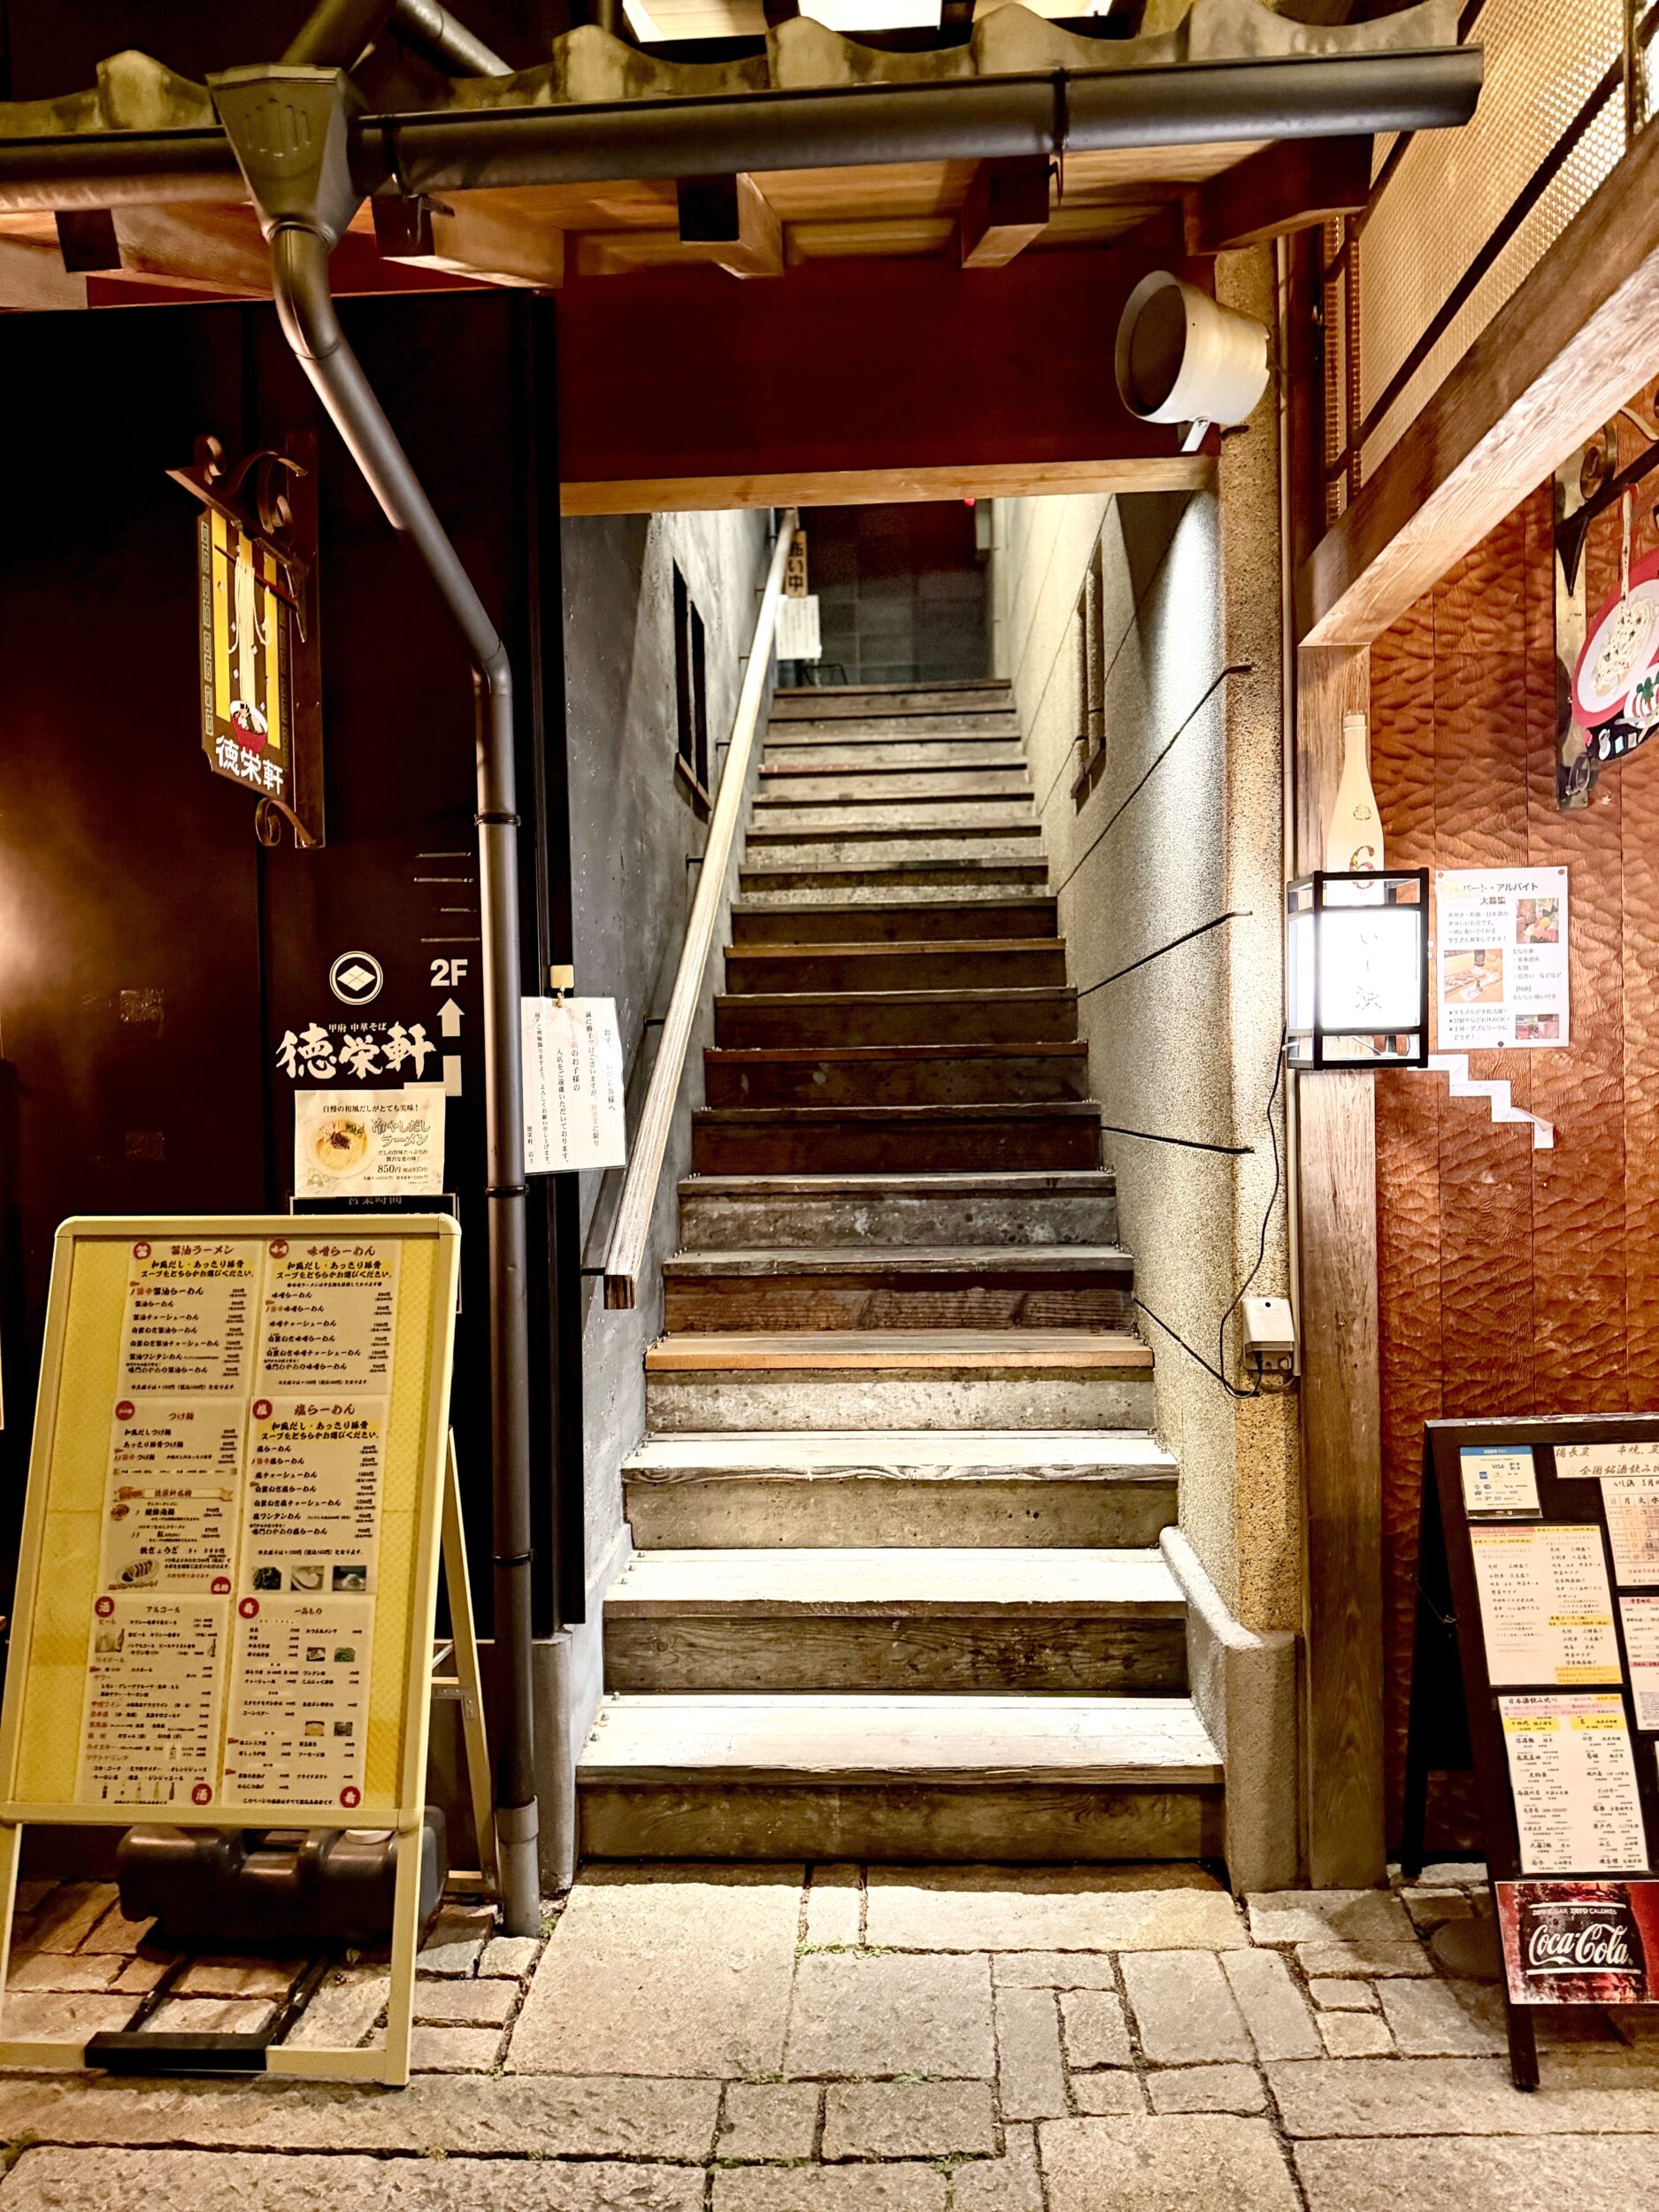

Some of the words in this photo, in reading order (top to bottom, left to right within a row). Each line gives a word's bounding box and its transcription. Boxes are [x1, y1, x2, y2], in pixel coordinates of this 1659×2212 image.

[215, 735, 283, 795] 徳栄軒
[1480, 896, 1506, 905] 大募集
[430, 959, 468, 987] 2F
[329, 1024, 347, 1033] 甲府
[276, 1021, 437, 1079] 徳栄軒
[372, 1118, 431, 1133] 冷やしだし
[381, 1133, 428, 1148] ラーメン
[172, 1246, 234, 1256] 醤油ラーメン
[307, 1246, 375, 1256] 味噌らーめん
[295, 1404, 356, 1416] 塩らーめん
[1529, 1924, 1629, 1965] Coca-Cola
